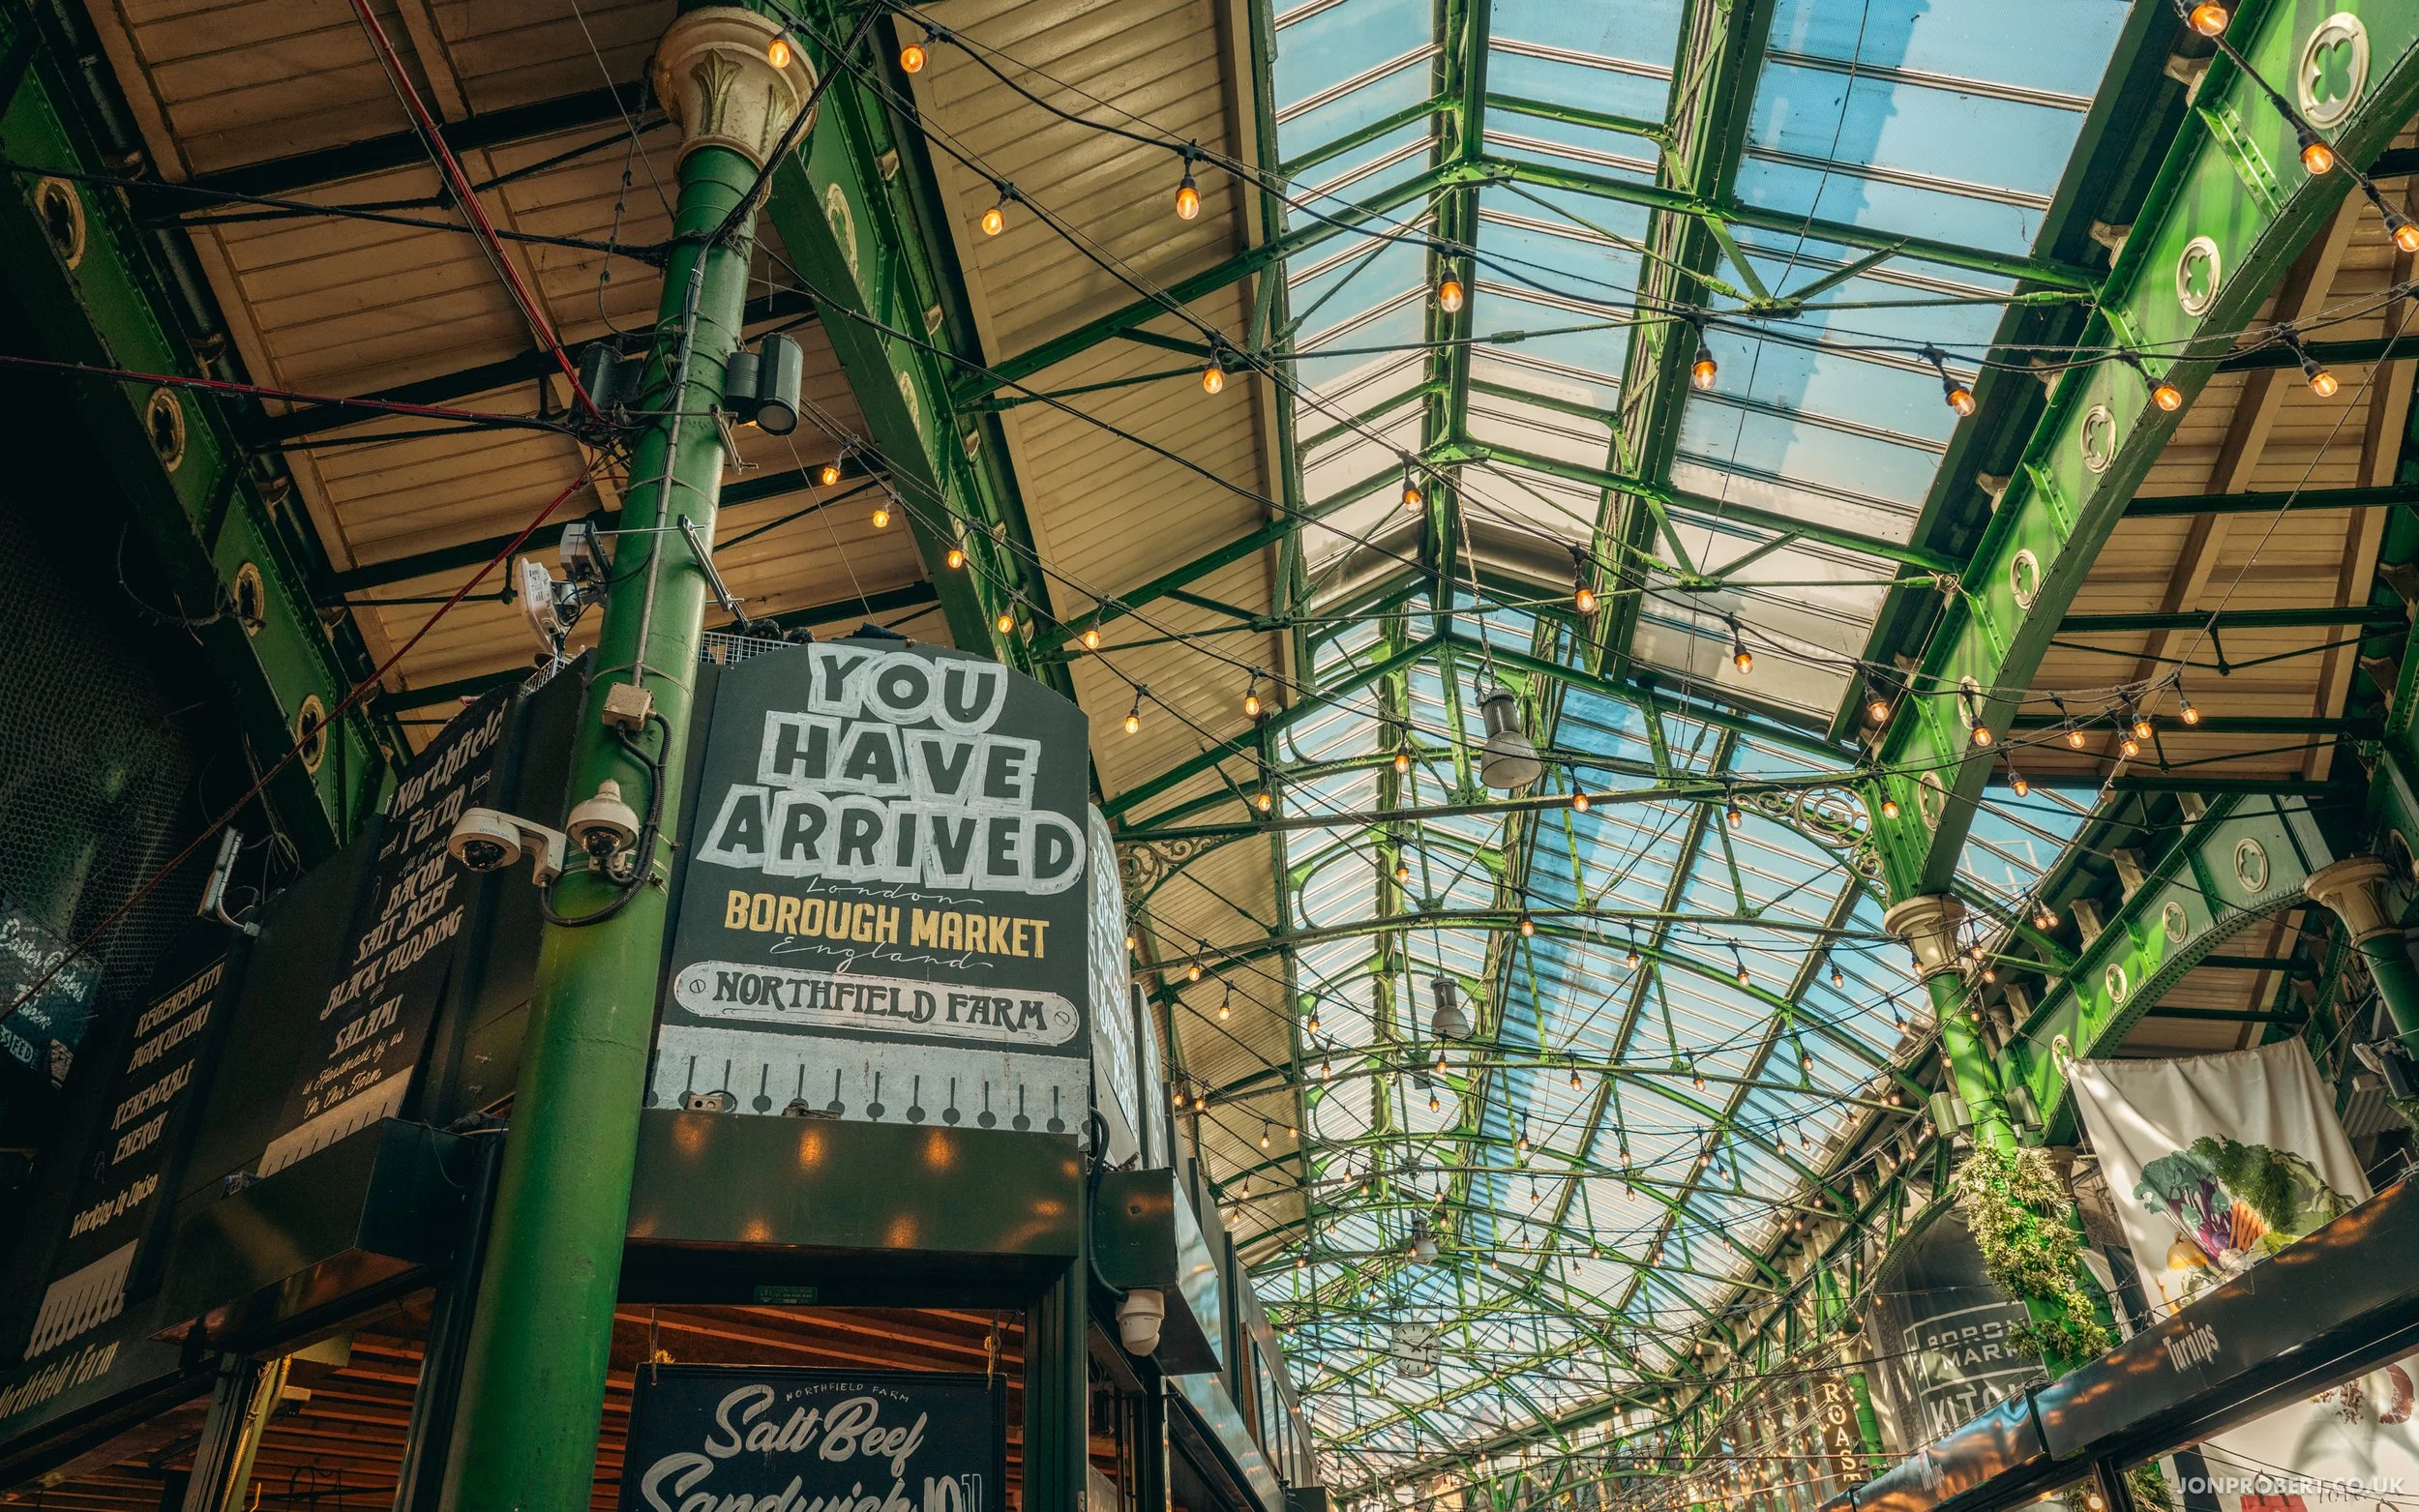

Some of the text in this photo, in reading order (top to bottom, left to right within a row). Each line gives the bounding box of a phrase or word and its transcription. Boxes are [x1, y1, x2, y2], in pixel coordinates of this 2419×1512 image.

[808, 642, 1007, 735] YOU
[390, 697, 508, 822] Northfield
[757, 710, 1041, 811] HAVE
[400, 784, 465, 854] Farm
[697, 784, 1087, 895] ARRIVED
[381, 851, 447, 921] BACON
[806, 876, 984, 904] London
[352, 873, 458, 965] SALT BEEF
[725, 889, 1050, 960] BOROUGH MARKET
[319, 904, 464, 1021] BLACK PUDDING
[769, 936, 994, 973] England
[329, 993, 404, 1060] SALAMI
[712, 970, 1049, 1032] NORTHFIELD FARM
[10, 1034, 34, 1063] FED
[314, 1045, 373, 1091] Handmade
[373, 1038, 388, 1064] by
[389, 1027, 405, 1047] us
[323, 1084, 346, 1109] Our
[348, 1068, 382, 1097] Farm
[111, 1111, 168, 1165] ENERGY
[70, 1200, 116, 1238] Working
[69, 1341, 120, 1389] Farm
[2162, 1320, 2220, 1374] Turnips
[785, 1382, 910, 1403] NORTHFIELD FARM
[704, 1384, 928, 1478] Salt Beef
